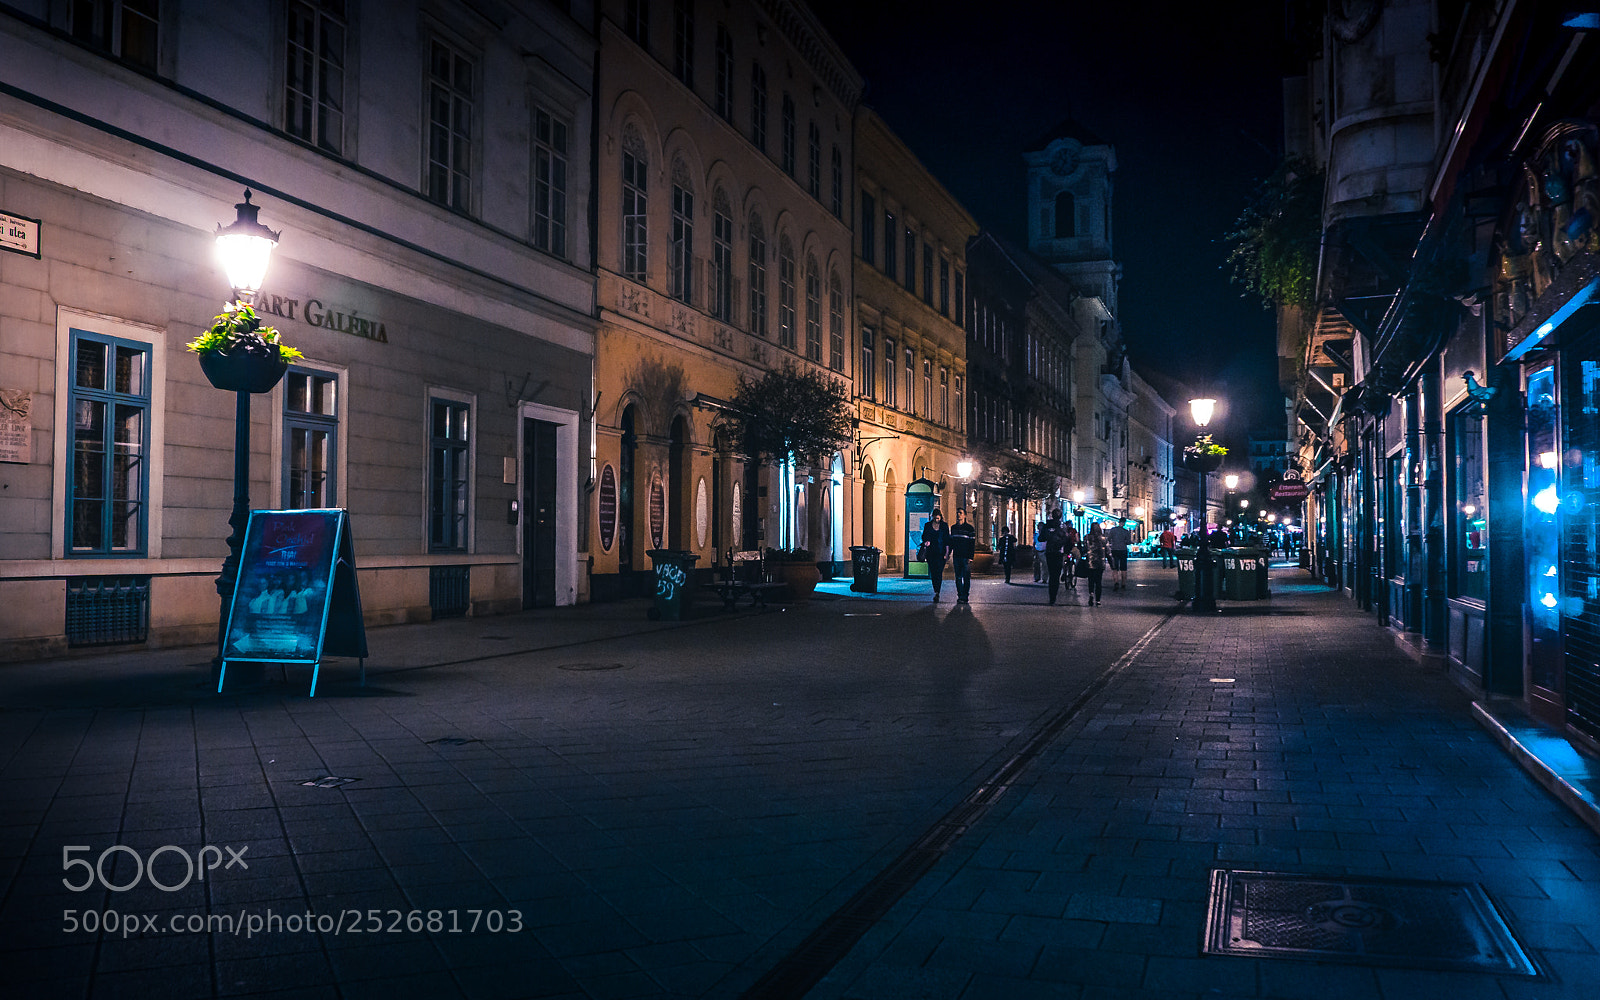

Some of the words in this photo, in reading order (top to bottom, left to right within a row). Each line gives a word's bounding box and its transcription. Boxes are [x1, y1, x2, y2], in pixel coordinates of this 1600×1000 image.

[304, 299, 389, 343] GALÉRIA
[1178, 559, 1194, 571] V56
[1239, 559, 1256, 571] V56
